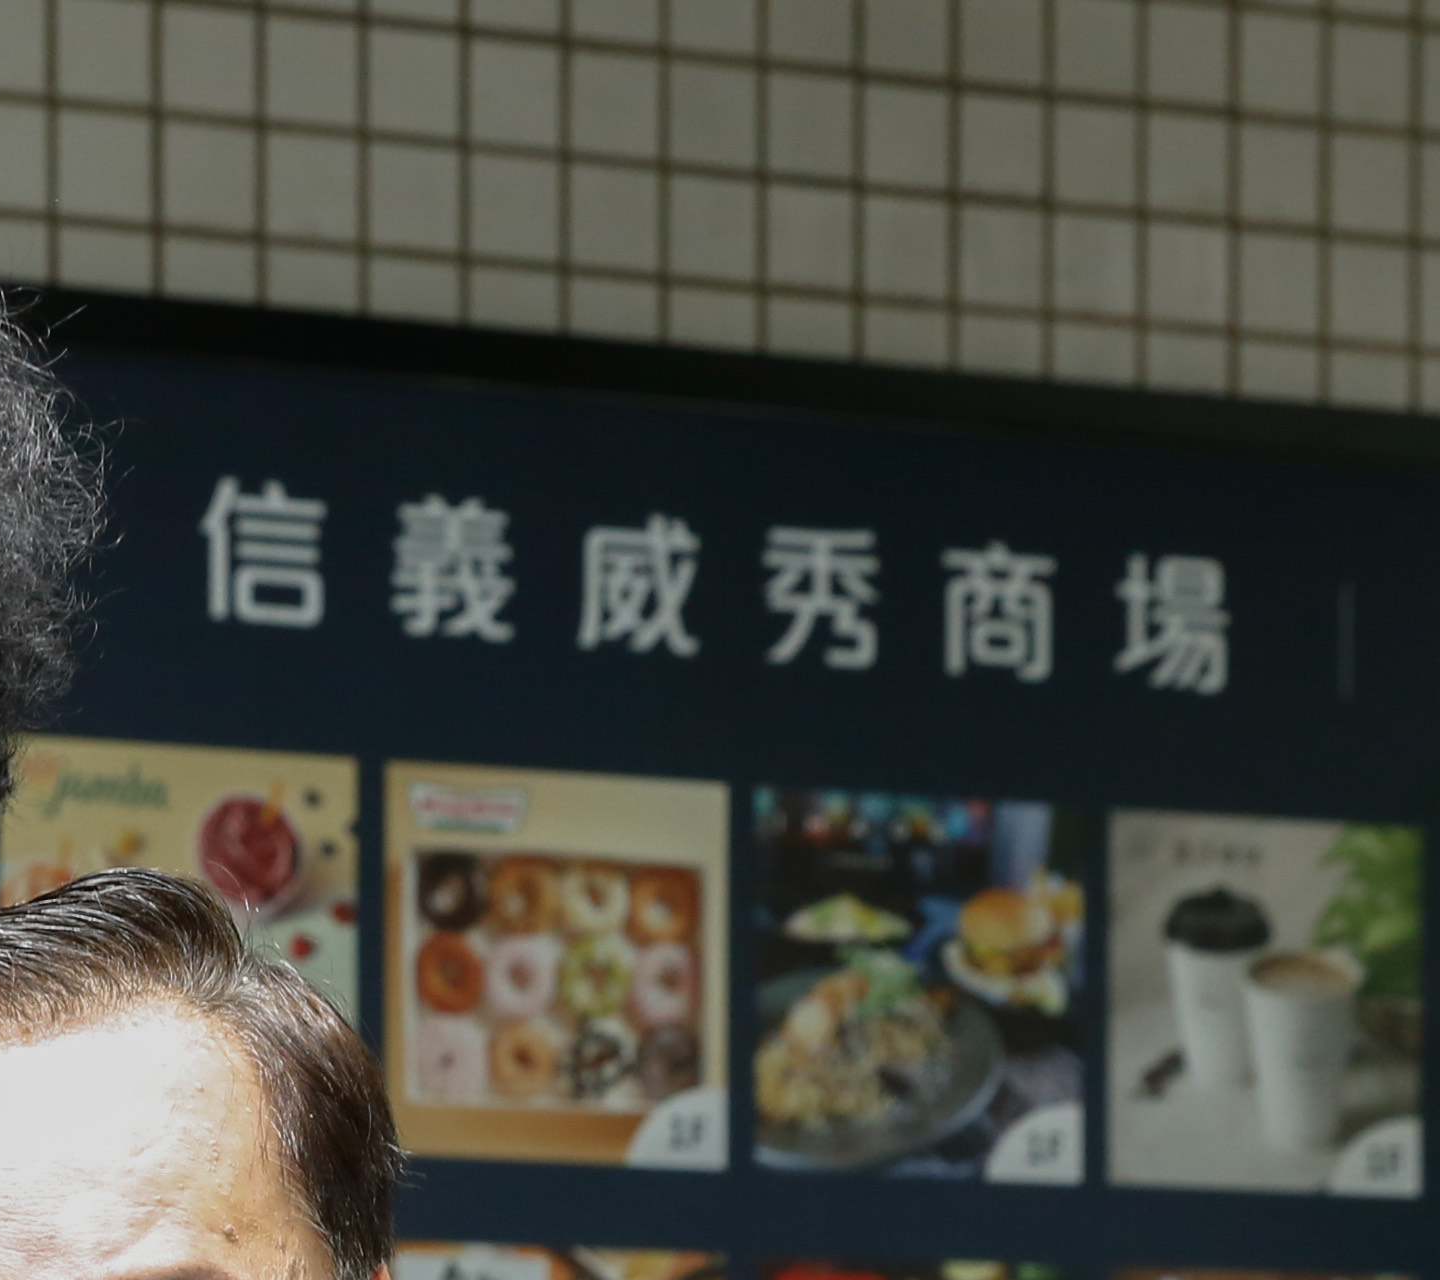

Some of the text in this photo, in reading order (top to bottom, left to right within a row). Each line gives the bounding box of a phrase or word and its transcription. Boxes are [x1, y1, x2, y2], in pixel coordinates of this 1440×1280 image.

[200, 475, 1232, 697] 信義威秀商場
